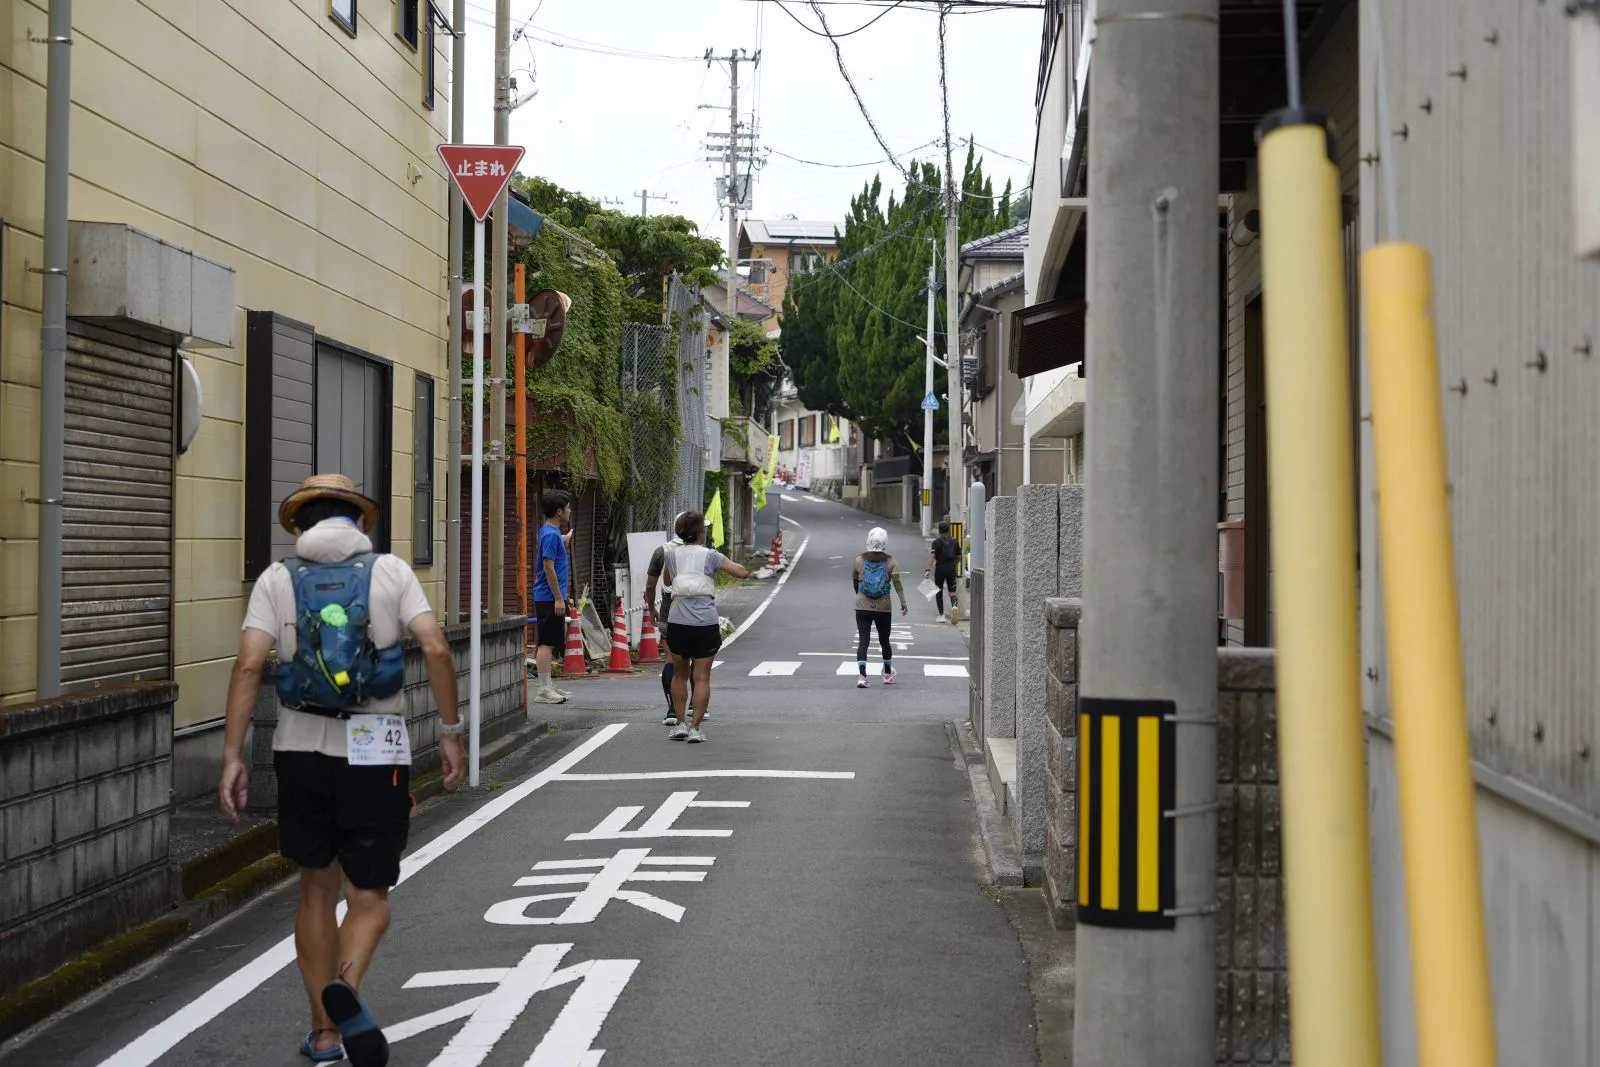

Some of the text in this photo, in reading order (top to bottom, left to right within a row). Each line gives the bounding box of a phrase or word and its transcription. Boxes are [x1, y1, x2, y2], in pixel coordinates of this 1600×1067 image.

[455, 159, 507, 177] 止まれ
[384, 729, 403, 747] 42
